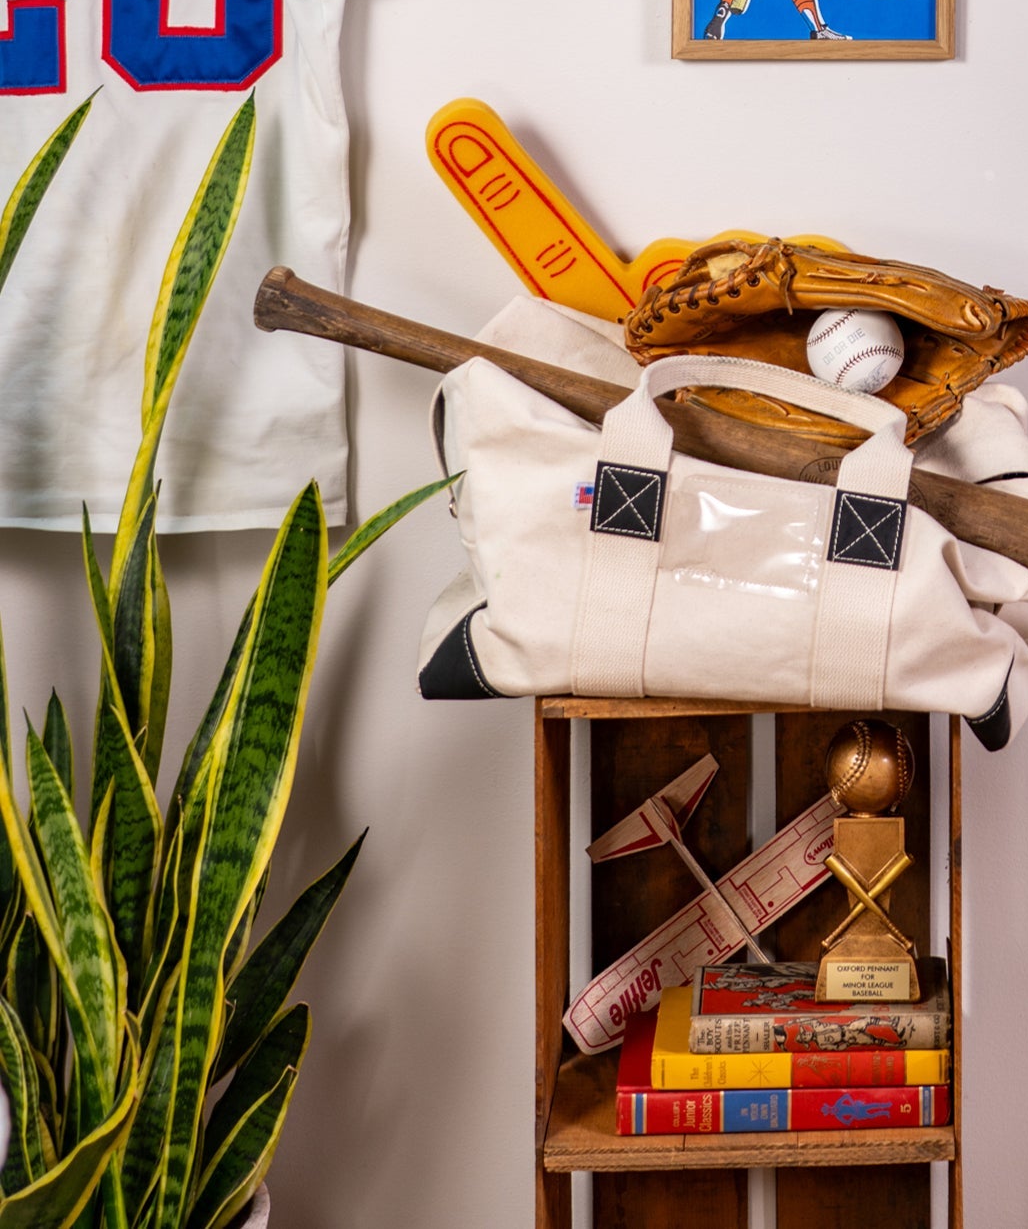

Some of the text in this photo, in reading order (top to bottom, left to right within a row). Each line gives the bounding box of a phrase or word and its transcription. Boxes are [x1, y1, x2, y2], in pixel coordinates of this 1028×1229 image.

[834, 341, 848, 354] OR
[847, 328, 866, 344] DIE
[608, 957, 663, 1027] Jetfire
[697, 1030, 705, 1046] The
[714, 1019, 722, 1054] SCOUTS
[690, 1067, 699, 1080] The
[683, 1099, 696, 1128] Junior
[699, 1094, 712, 1132] Classics
[900, 1103, 911, 1114] 5
